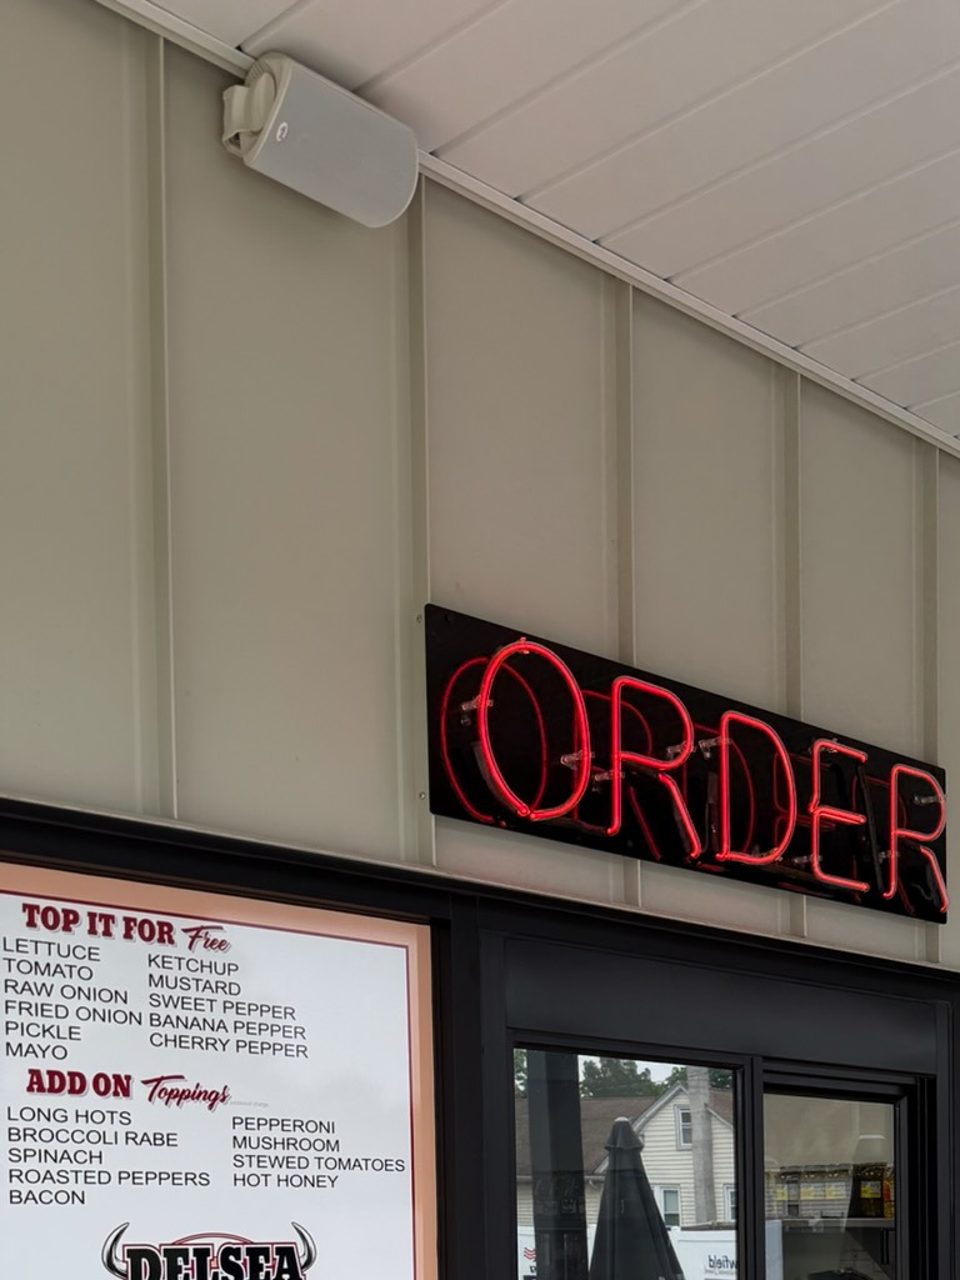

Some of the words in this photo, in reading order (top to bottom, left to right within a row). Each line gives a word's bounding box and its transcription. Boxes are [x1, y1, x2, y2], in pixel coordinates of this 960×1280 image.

[477, 639, 948, 913] ORDER
[22, 904, 79, 932] TOP
[87, 911, 114, 937] IT
[123, 916, 176, 945] FOR
[181, 925, 232, 953] Free
[2, 937, 101, 962] LETTUCE
[2, 957, 94, 981] TOMATO
[147, 953, 239, 976] KETCHUP
[4, 979, 54, 998] RAW
[60, 984, 129, 1004] ONION
[148, 974, 241, 996] MUSTARD
[4, 1000, 70, 1020] FRIED
[75, 1006, 142, 1026] ONION
[148, 994, 218, 1013] SWEET
[222, 1000, 296, 1020] PEPPER
[5, 1021, 82, 1041] PICKLE
[149, 1013, 229, 1034] BANANA
[233, 1020, 306, 1040] PEPPER
[5, 1042, 68, 1061] MAYO
[149, 1033, 230, 1053] CHERRY
[235, 1040, 309, 1059] PEPPER
[26, 1068, 87, 1096] ADD
[92, 1073, 132, 1098] ON
[140, 1074, 231, 1111] Toppings
[7, 1106, 69, 1124] LONG
[74, 1108, 132, 1126] HOTS
[232, 1116, 335, 1134] PEPPERONI
[7, 1127, 119, 1146] BROCCOLI
[124, 1131, 179, 1147] RABE
[232, 1136, 340, 1152] MUSHROOM
[8, 1148, 103, 1164] SPINACH
[233, 1155, 309, 1171] STEWED
[314, 1156, 405, 1173] TOMATOES
[8, 1169, 112, 1185] ROASTED
[118, 1170, 210, 1187] PEPPERS
[233, 1173, 270, 1187] HOT
[277, 1174, 339, 1188] HONEY
[9, 1189, 86, 1205] BACON
